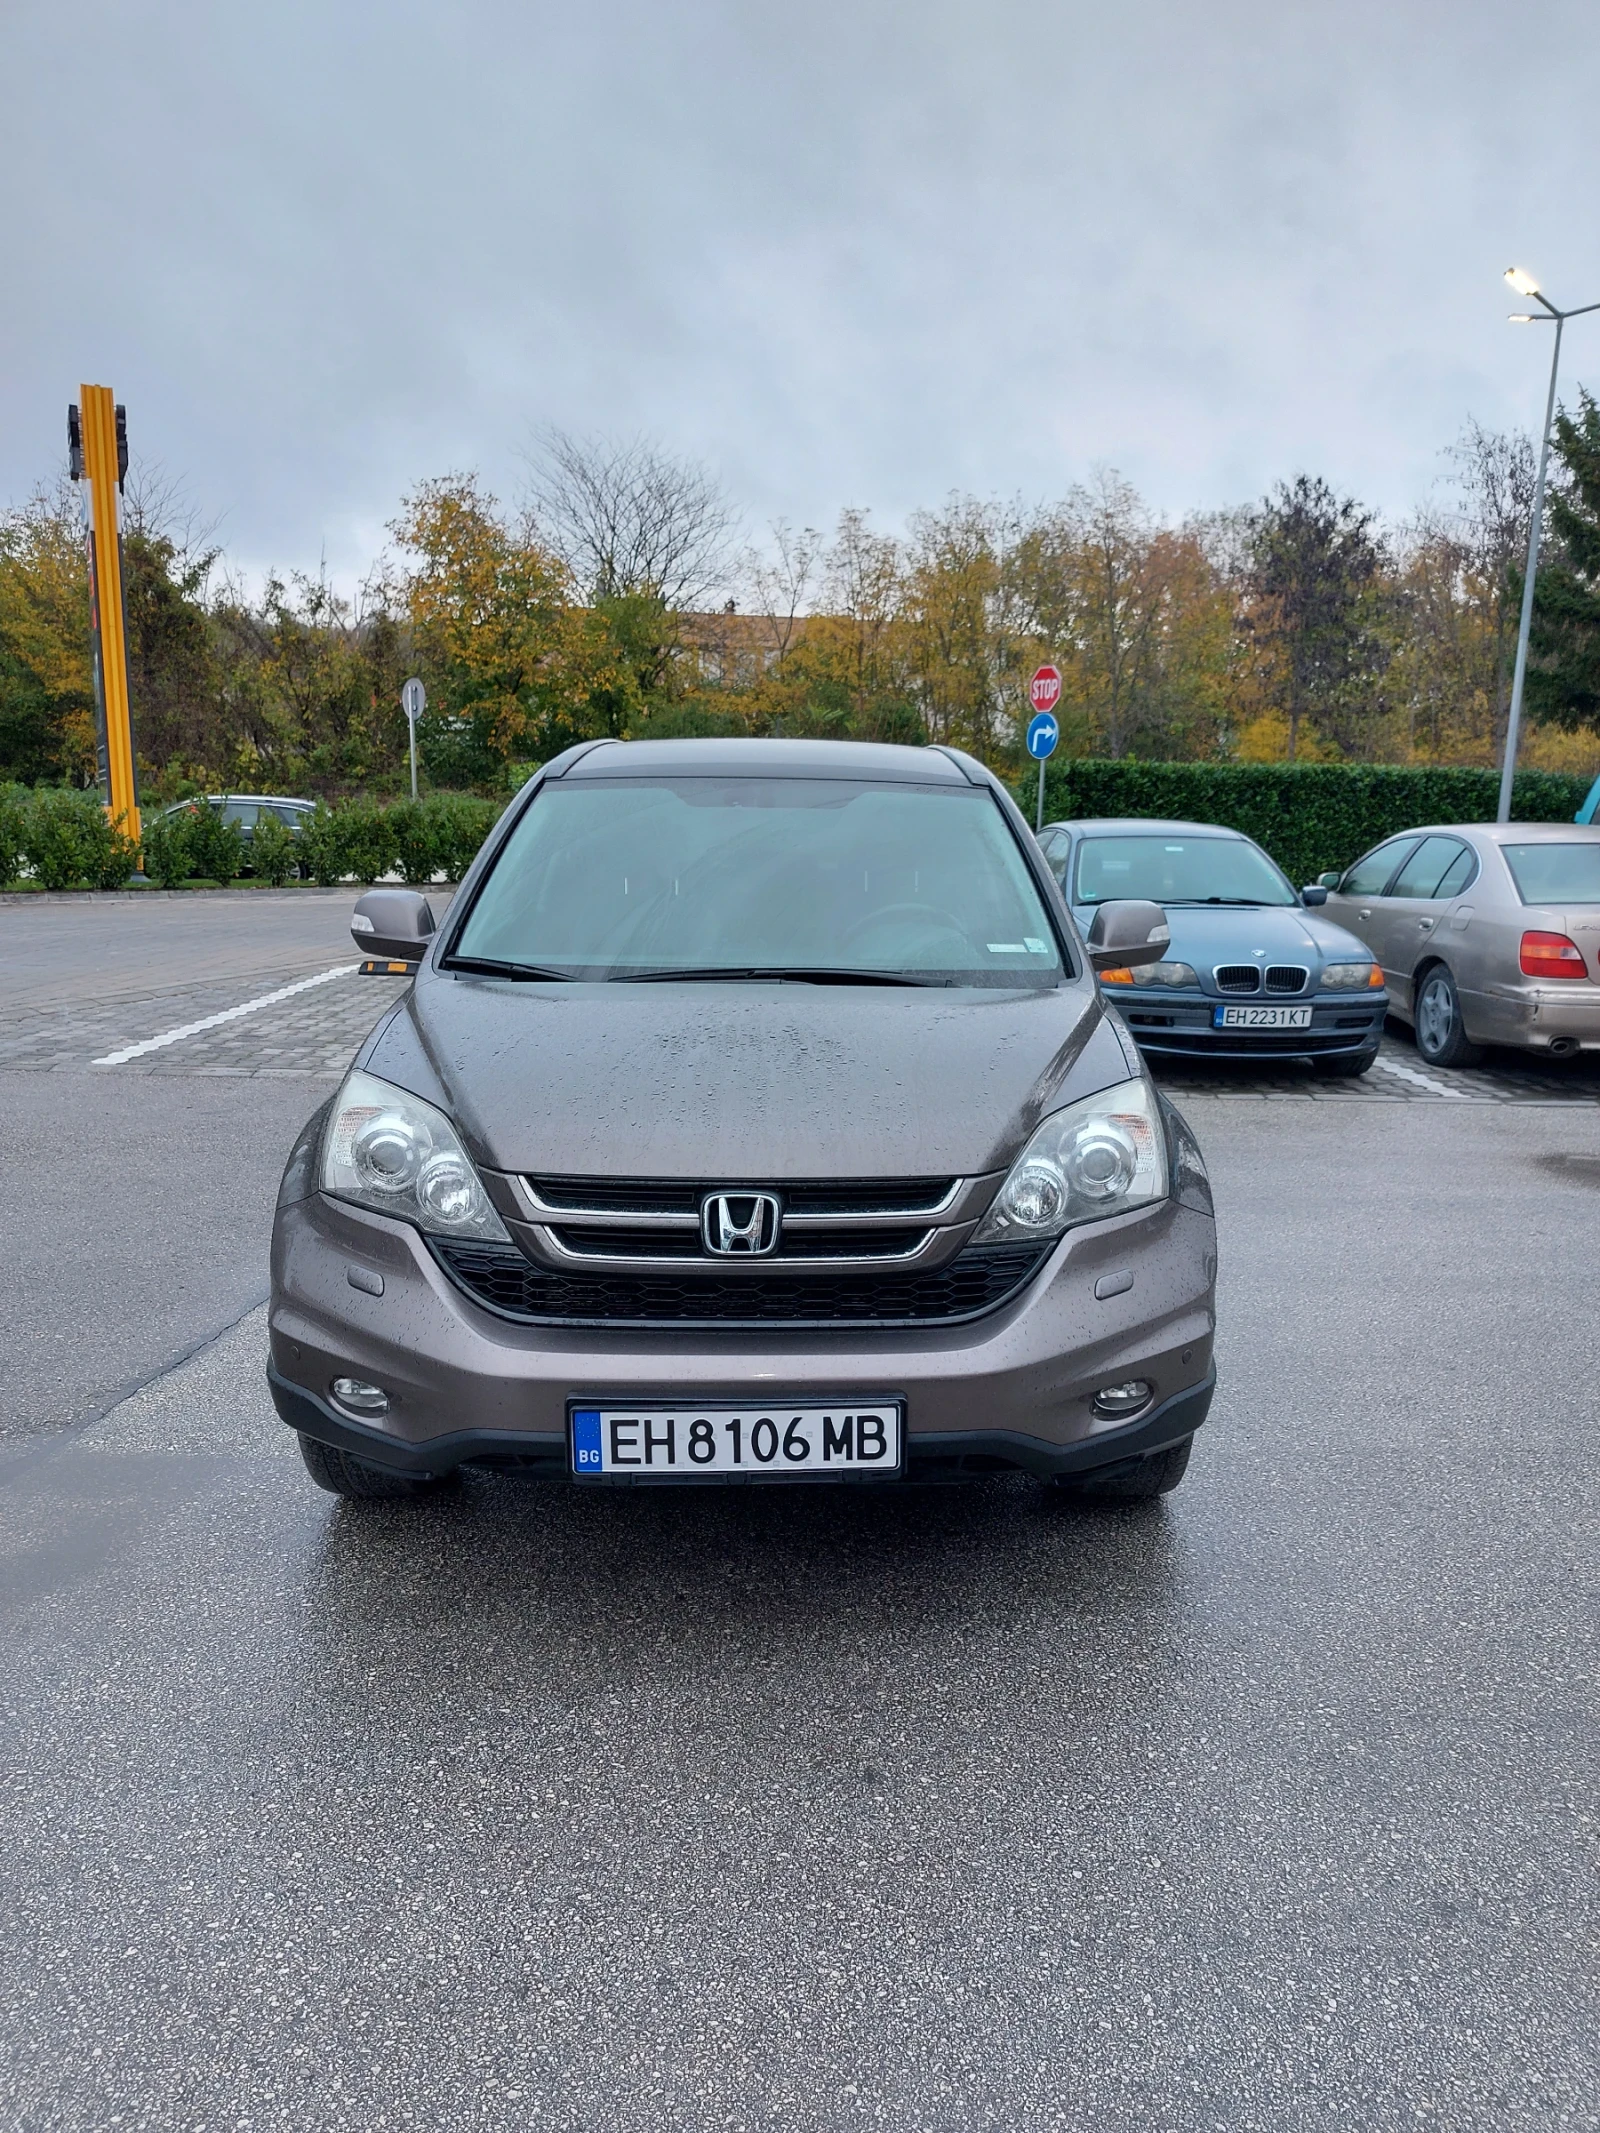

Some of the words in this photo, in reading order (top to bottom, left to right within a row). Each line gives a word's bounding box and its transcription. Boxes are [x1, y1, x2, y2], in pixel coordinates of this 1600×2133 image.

[1032, 679, 1058, 700] STOP
[1225, 1009, 1247, 1024] EH
[1249, 1010, 1285, 1025] 2231
[1289, 1010, 1309, 1025] KT
[609, 1418, 676, 1465] EH
[687, 1417, 811, 1464] 8106
[822, 1415, 888, 1461] MB
[578, 1450, 600, 1464] BG
